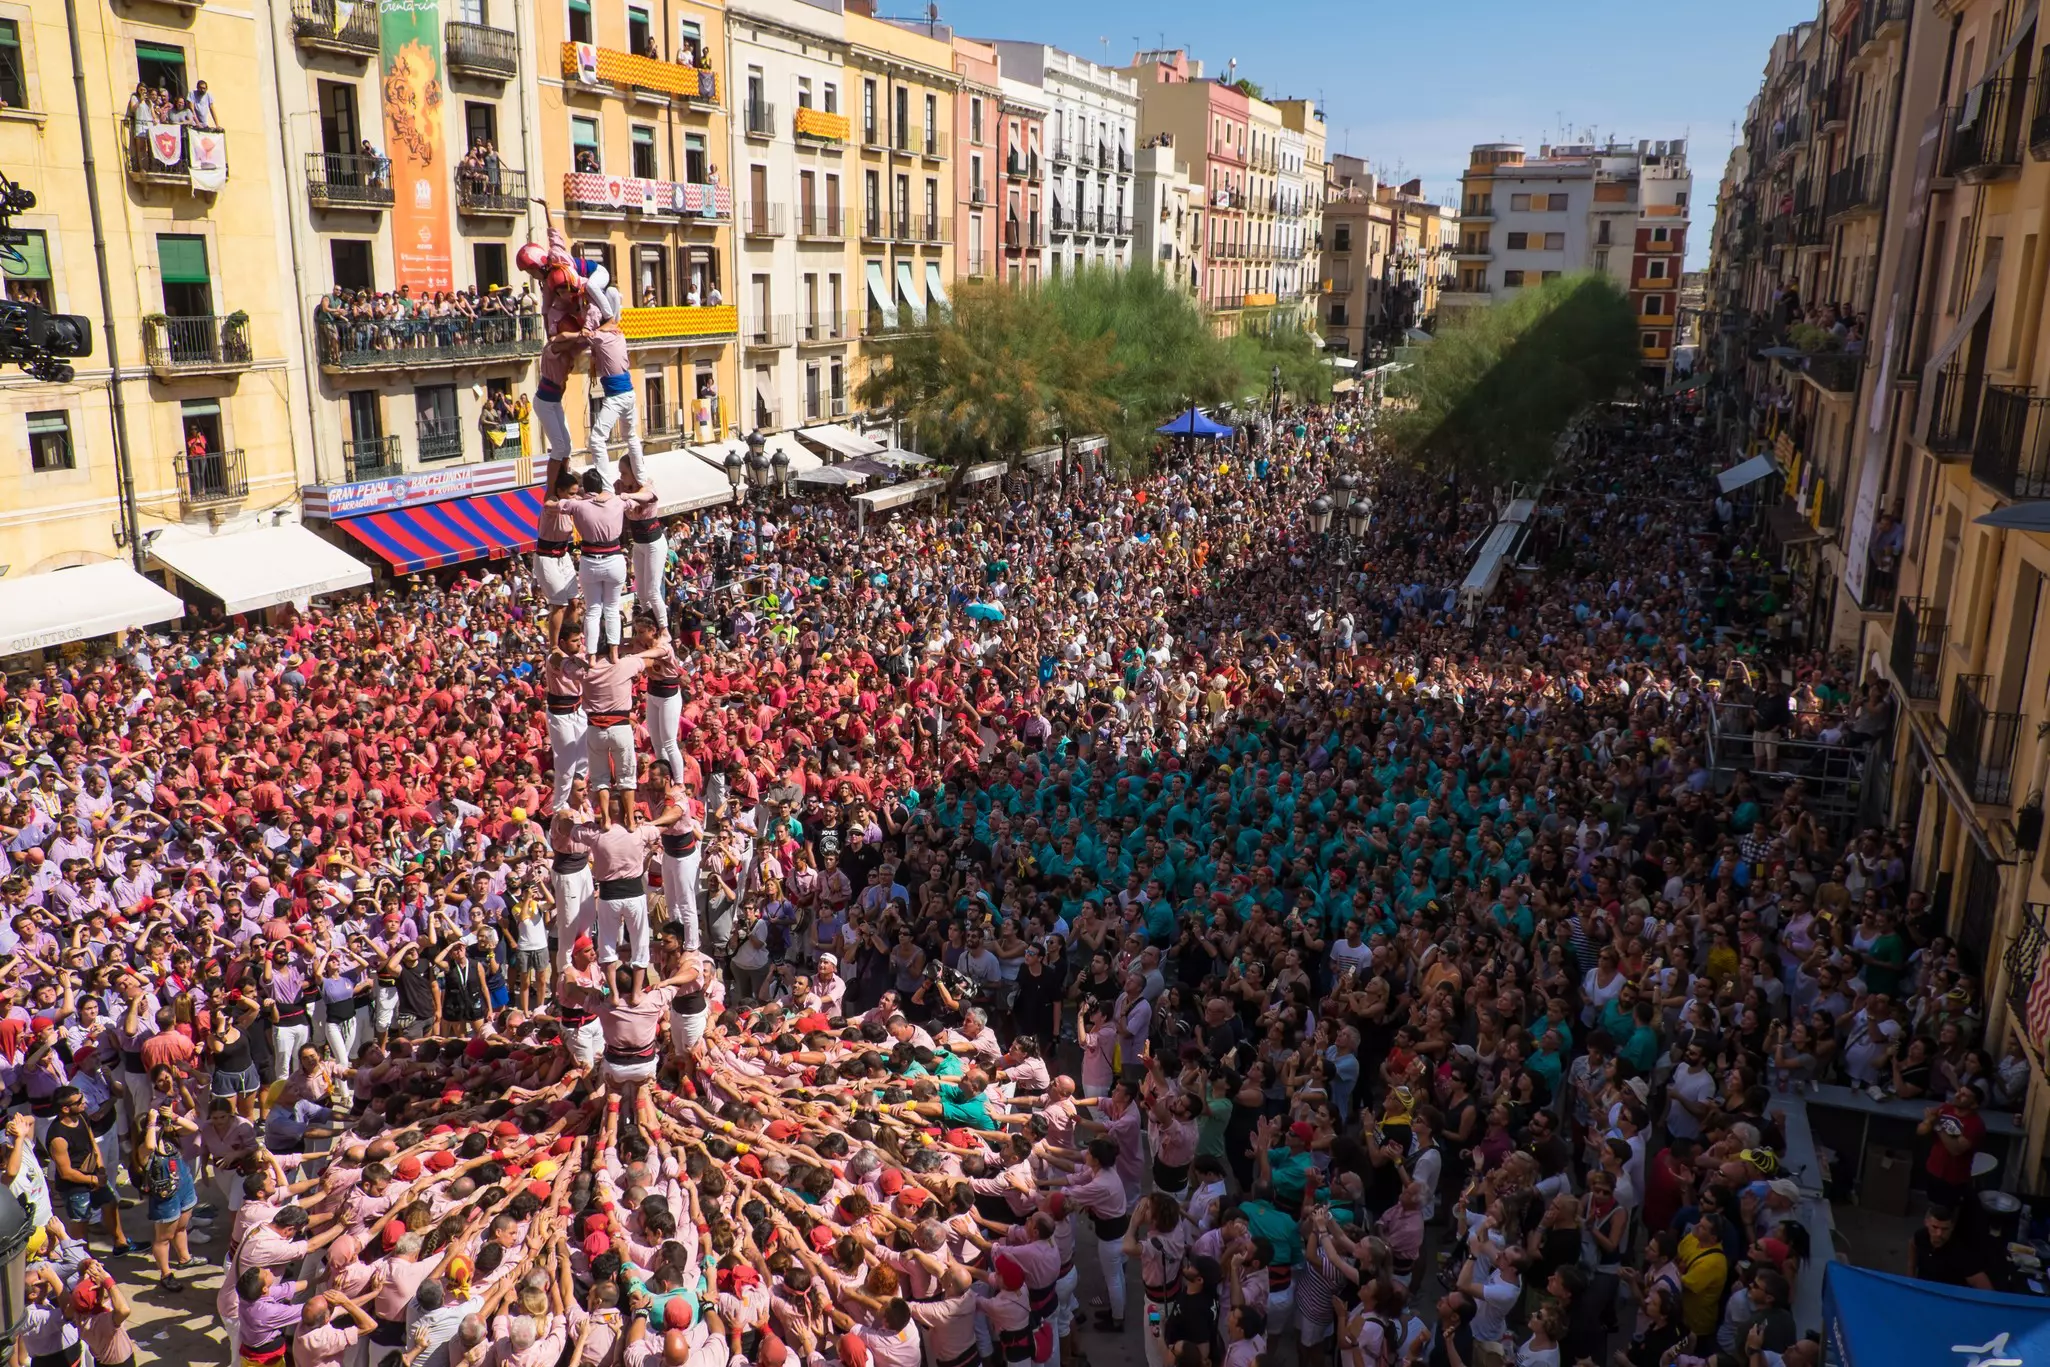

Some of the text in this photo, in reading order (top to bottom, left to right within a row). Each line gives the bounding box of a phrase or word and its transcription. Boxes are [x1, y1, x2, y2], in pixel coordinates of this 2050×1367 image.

[329, 469, 471, 503] GRAN PENYA BARCELONISTA
[336, 498, 379, 512] TARRAGONA
[276, 582, 328, 602] QUATTROS
[12, 626, 83, 652] QUATTROS
